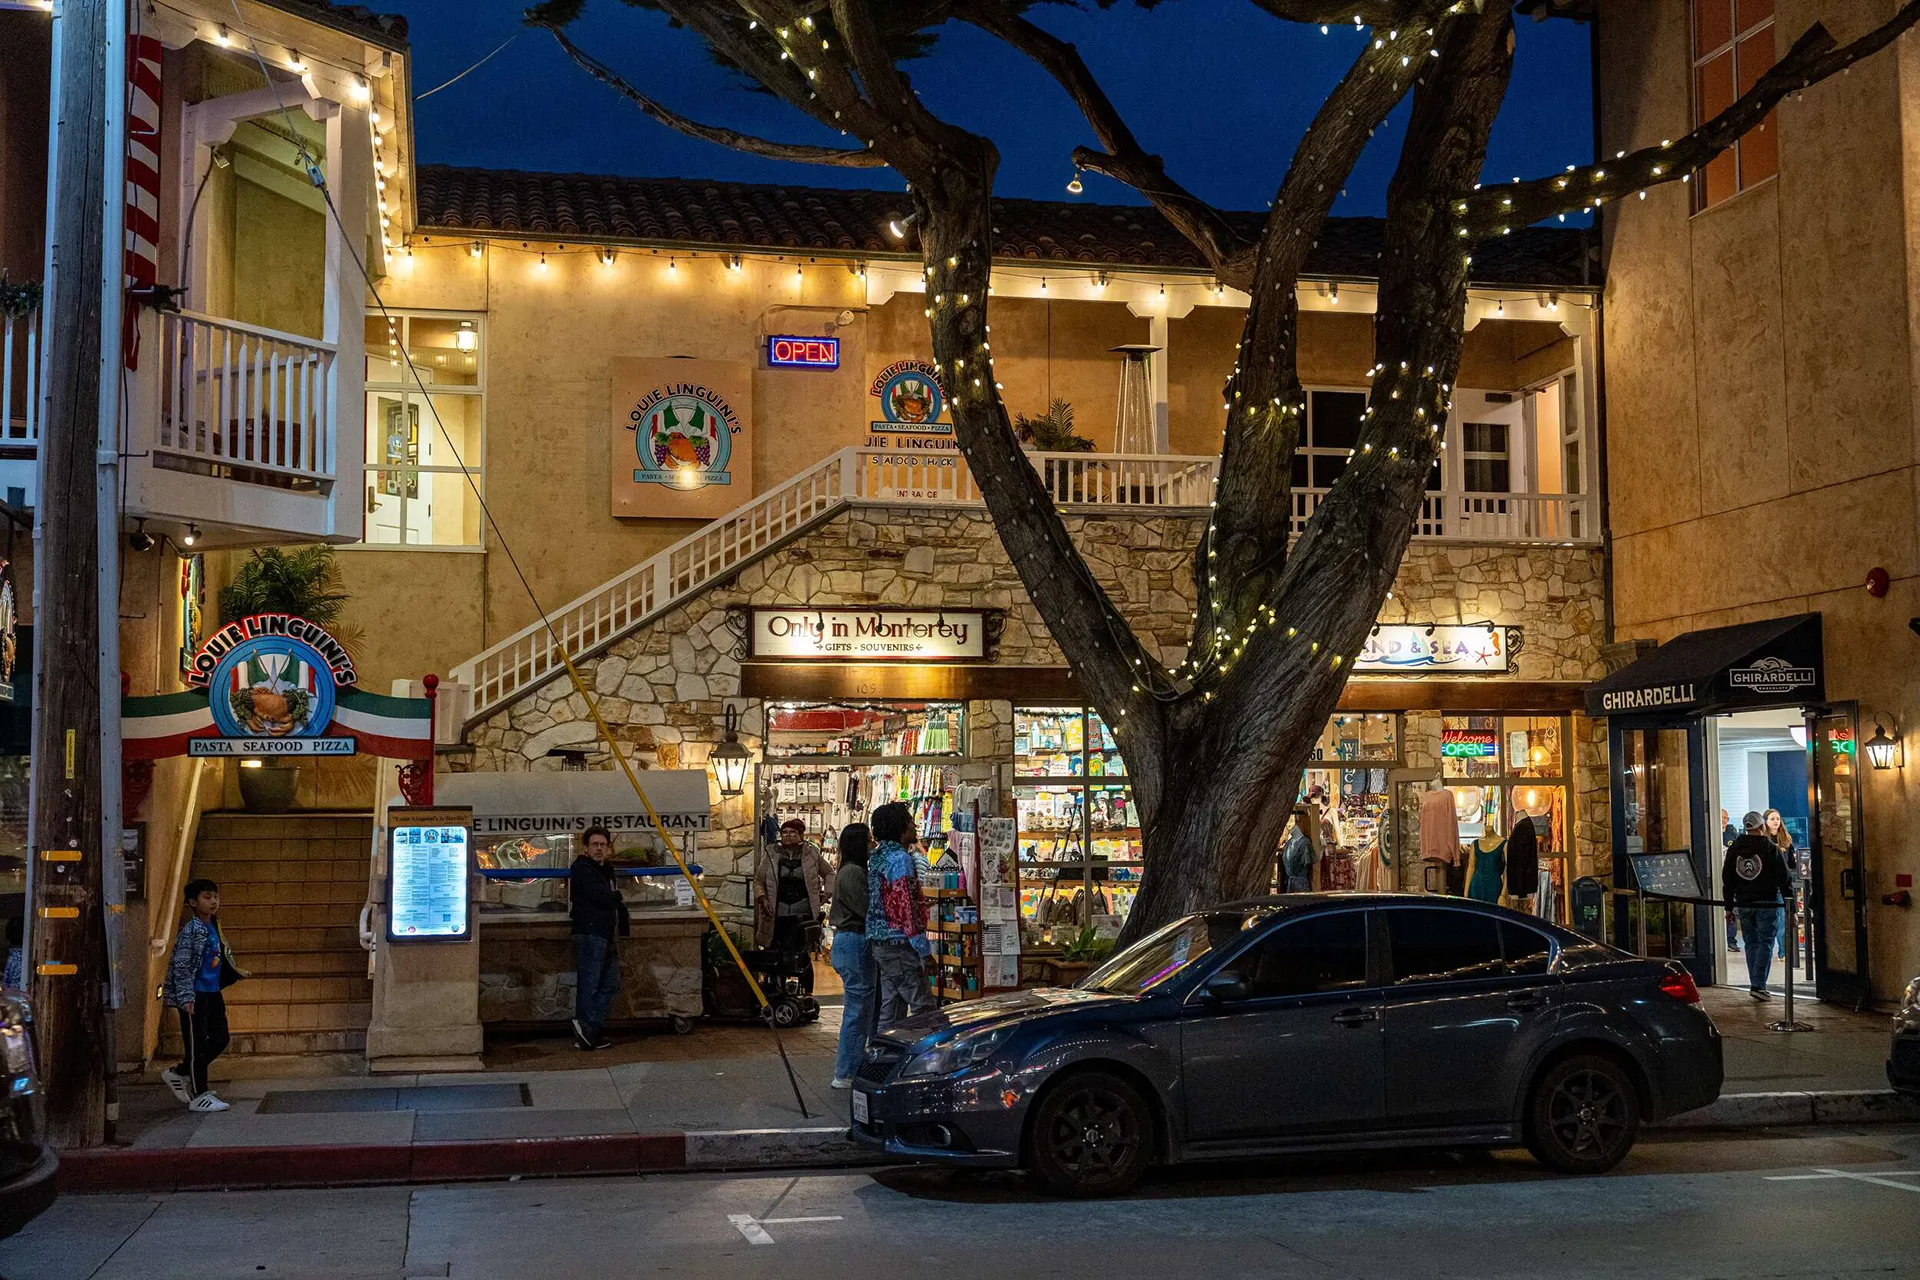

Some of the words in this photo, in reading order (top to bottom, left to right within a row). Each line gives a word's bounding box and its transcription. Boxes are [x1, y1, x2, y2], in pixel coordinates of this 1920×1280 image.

[775, 341, 834, 362] OPEN
[871, 364, 899, 396] LOUIE
[625, 388, 664, 432] LOUIE
[666, 382, 742, 435] LINGUINI'S
[641, 473, 663, 481] PASTA
[704, 474, 723, 482] PIZZA
[768, 616, 824, 644] Only
[832, 617, 849, 637] in
[855, 616, 968, 645] Monterey
[189, 623, 245, 685] LOUIE
[244, 614, 357, 686] LINGUINI'S
[825, 643, 852, 651] GIFTS
[860, 643, 914, 651] SOUVENIRS
[1410, 640, 1422, 654] &
[1429, 640, 1470, 655] SEA
[1733, 672, 1812, 683] GHIRARDELLI
[1602, 684, 1694, 710] GHIRARDELLI
[1441, 730, 1493, 743] Welcome
[194, 741, 234, 752] PASTA
[243, 741, 303, 751] SEAFOOD
[312, 741, 351, 751] PIZZA
[1445, 743, 1484, 755] OPEN
[488, 814, 585, 832] LINGUINI'S
[592, 814, 708, 830] RESTAURANT
